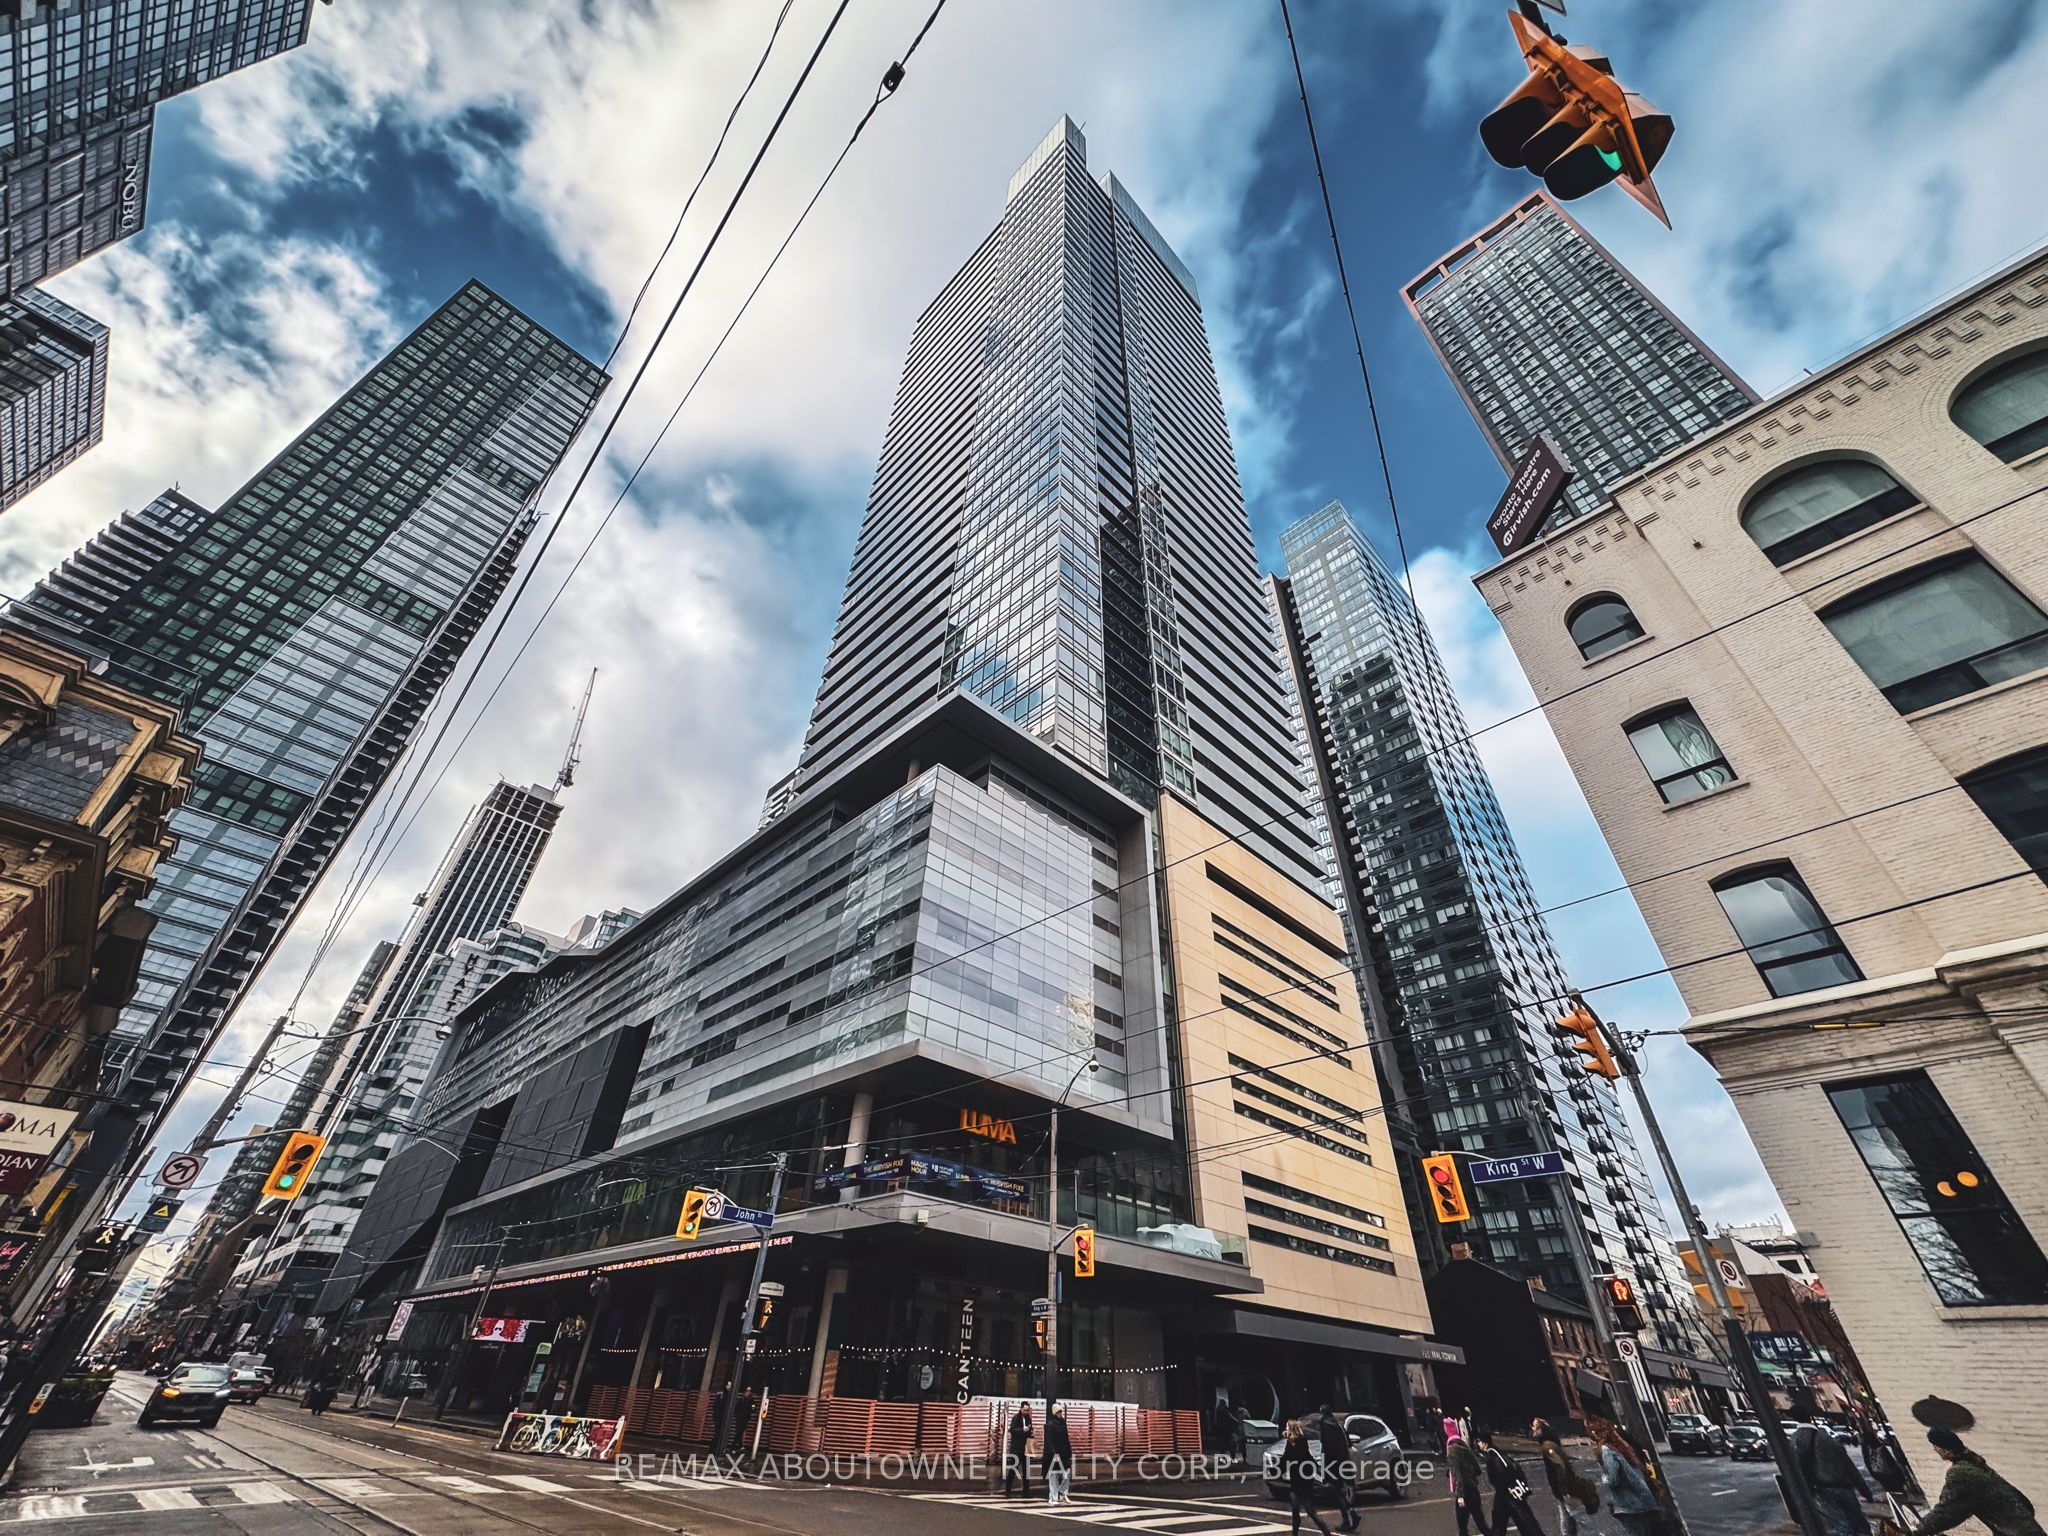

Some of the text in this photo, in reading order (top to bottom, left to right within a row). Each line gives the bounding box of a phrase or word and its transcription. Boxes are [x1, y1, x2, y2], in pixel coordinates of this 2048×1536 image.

[121, 160, 139, 229] NOBU
[1492, 449, 1541, 531] Toronto Theatre
[1502, 468, 1538, 527] Starts Here
[959, 1107, 1017, 1145] LUMA
[911, 1159, 928, 1170] MAGIC
[911, 1166, 927, 1176] HOUR
[1485, 1155, 1545, 1177] King St W
[735, 1208, 755, 1221] John
[957, 1299, 974, 1405] CANTEEN
